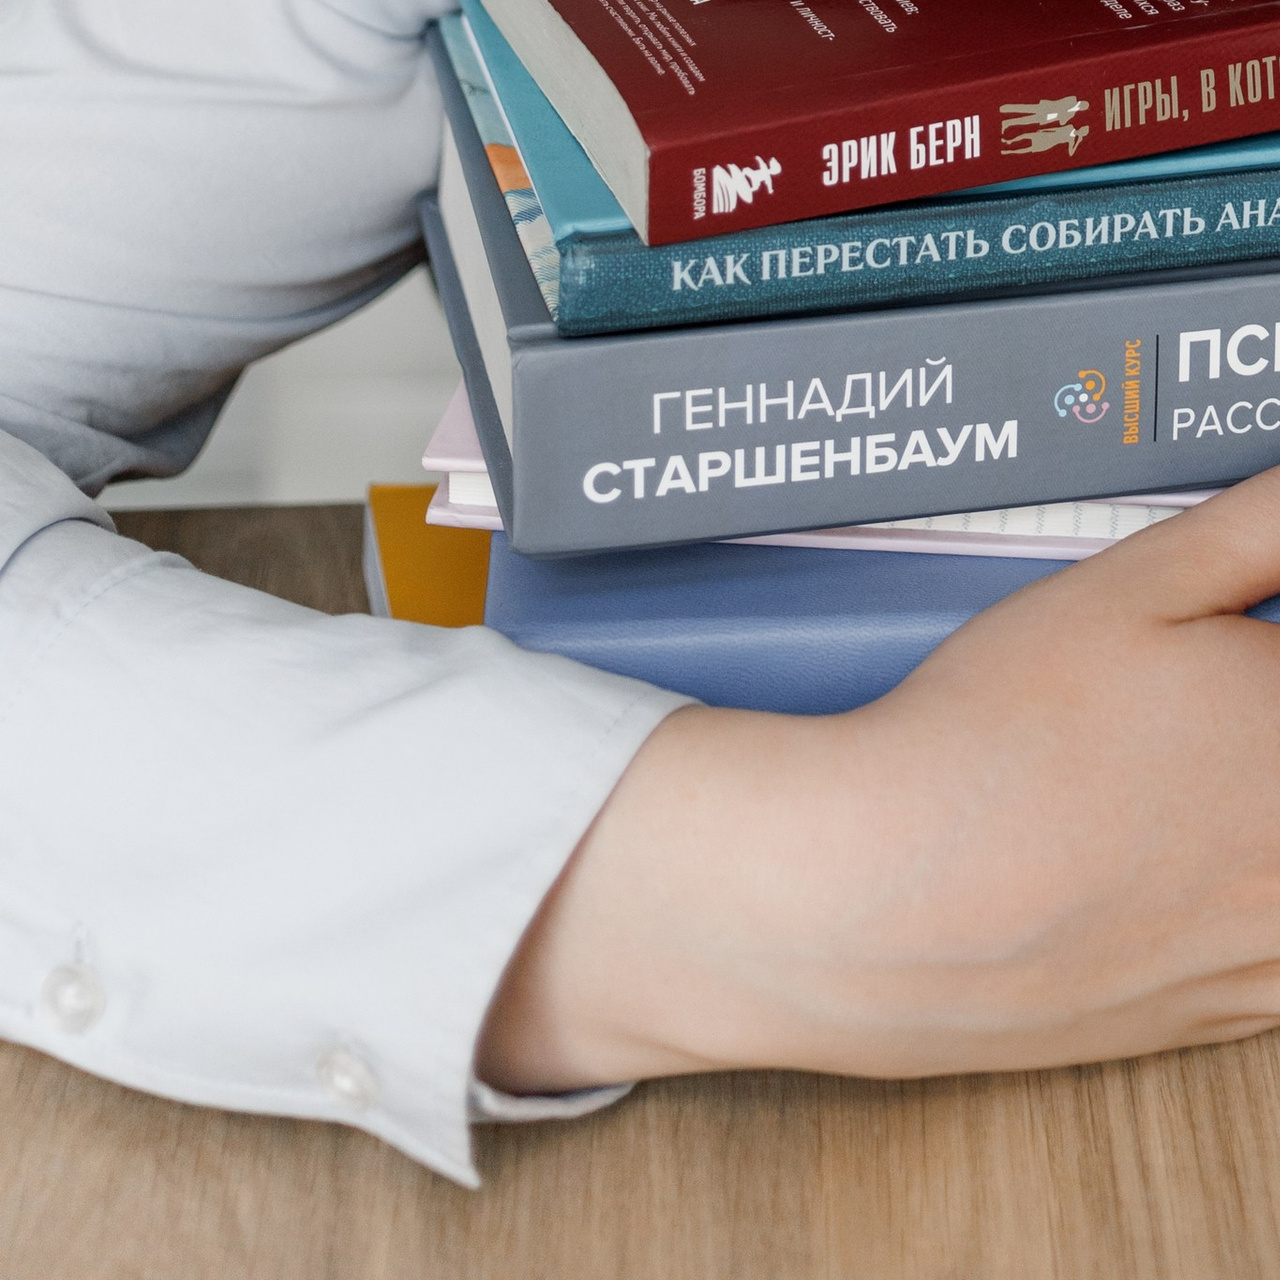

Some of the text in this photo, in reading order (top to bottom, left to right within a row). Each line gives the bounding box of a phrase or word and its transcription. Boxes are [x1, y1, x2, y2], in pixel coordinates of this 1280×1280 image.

[796, 7, 835, 41] личност-
[1099, 0, 1133, 20] деле
[669, 61, 696, 96] пробовать
[1103, 75, 1190, 132] ИГРЫ,
[1201, 70, 1218, 111] В
[822, 115, 981, 186] ЭРИК БЕРН
[692, 167, 706, 220] БОМБОРА
[672, 254, 751, 291] КАК
[761, 227, 990, 281] ПЕРЕСТАТЬ
[1001, 206, 1206, 255] СОБИРАТЬ
[651, 356, 955, 434] ГЕННАДИЙ
[1121, 338, 1142, 445] ВЫСШИЙ КУРС
[581, 420, 1018, 503] СТАРШЕНБАУМ
